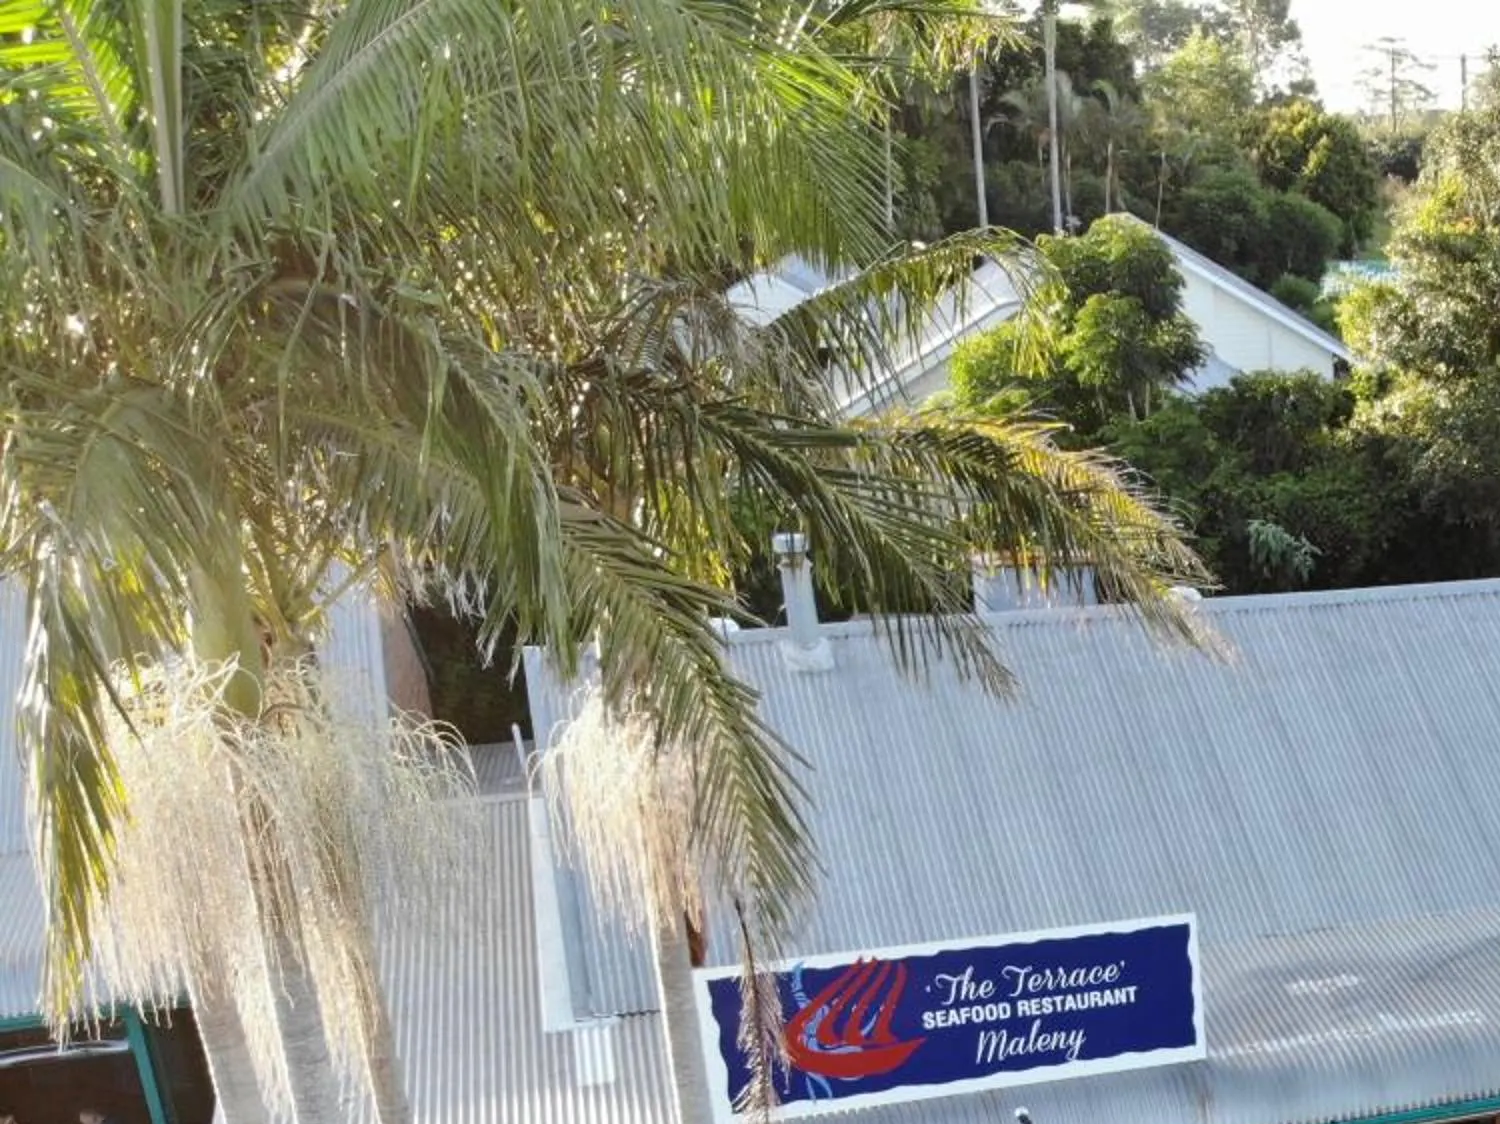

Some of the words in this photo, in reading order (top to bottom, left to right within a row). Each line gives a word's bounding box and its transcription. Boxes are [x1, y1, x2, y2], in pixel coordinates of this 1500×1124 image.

[922, 1001, 1012, 1030] SEAFOOD
[1017, 986, 1137, 1018] RESTAURANT
[975, 1019, 1086, 1064] Maleny
